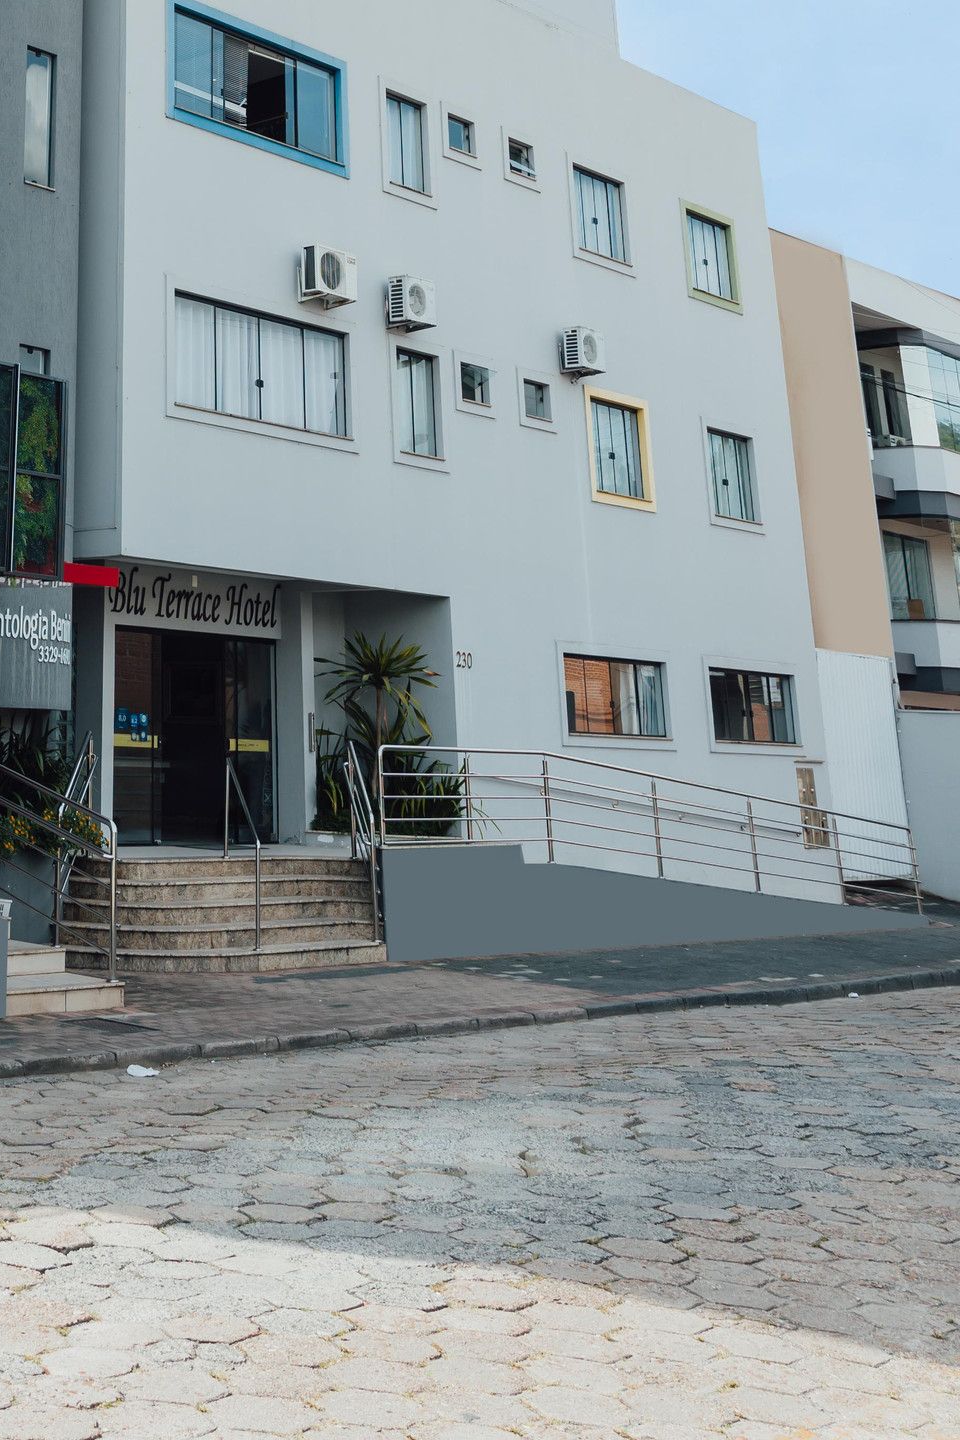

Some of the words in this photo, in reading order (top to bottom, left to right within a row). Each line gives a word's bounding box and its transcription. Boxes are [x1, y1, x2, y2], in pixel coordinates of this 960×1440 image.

[109, 566, 147, 616] Blu
[152, 573, 221, 623] Terrace
[225, 583, 282, 628] Hotel
[456, 651, 473, 669] 230
